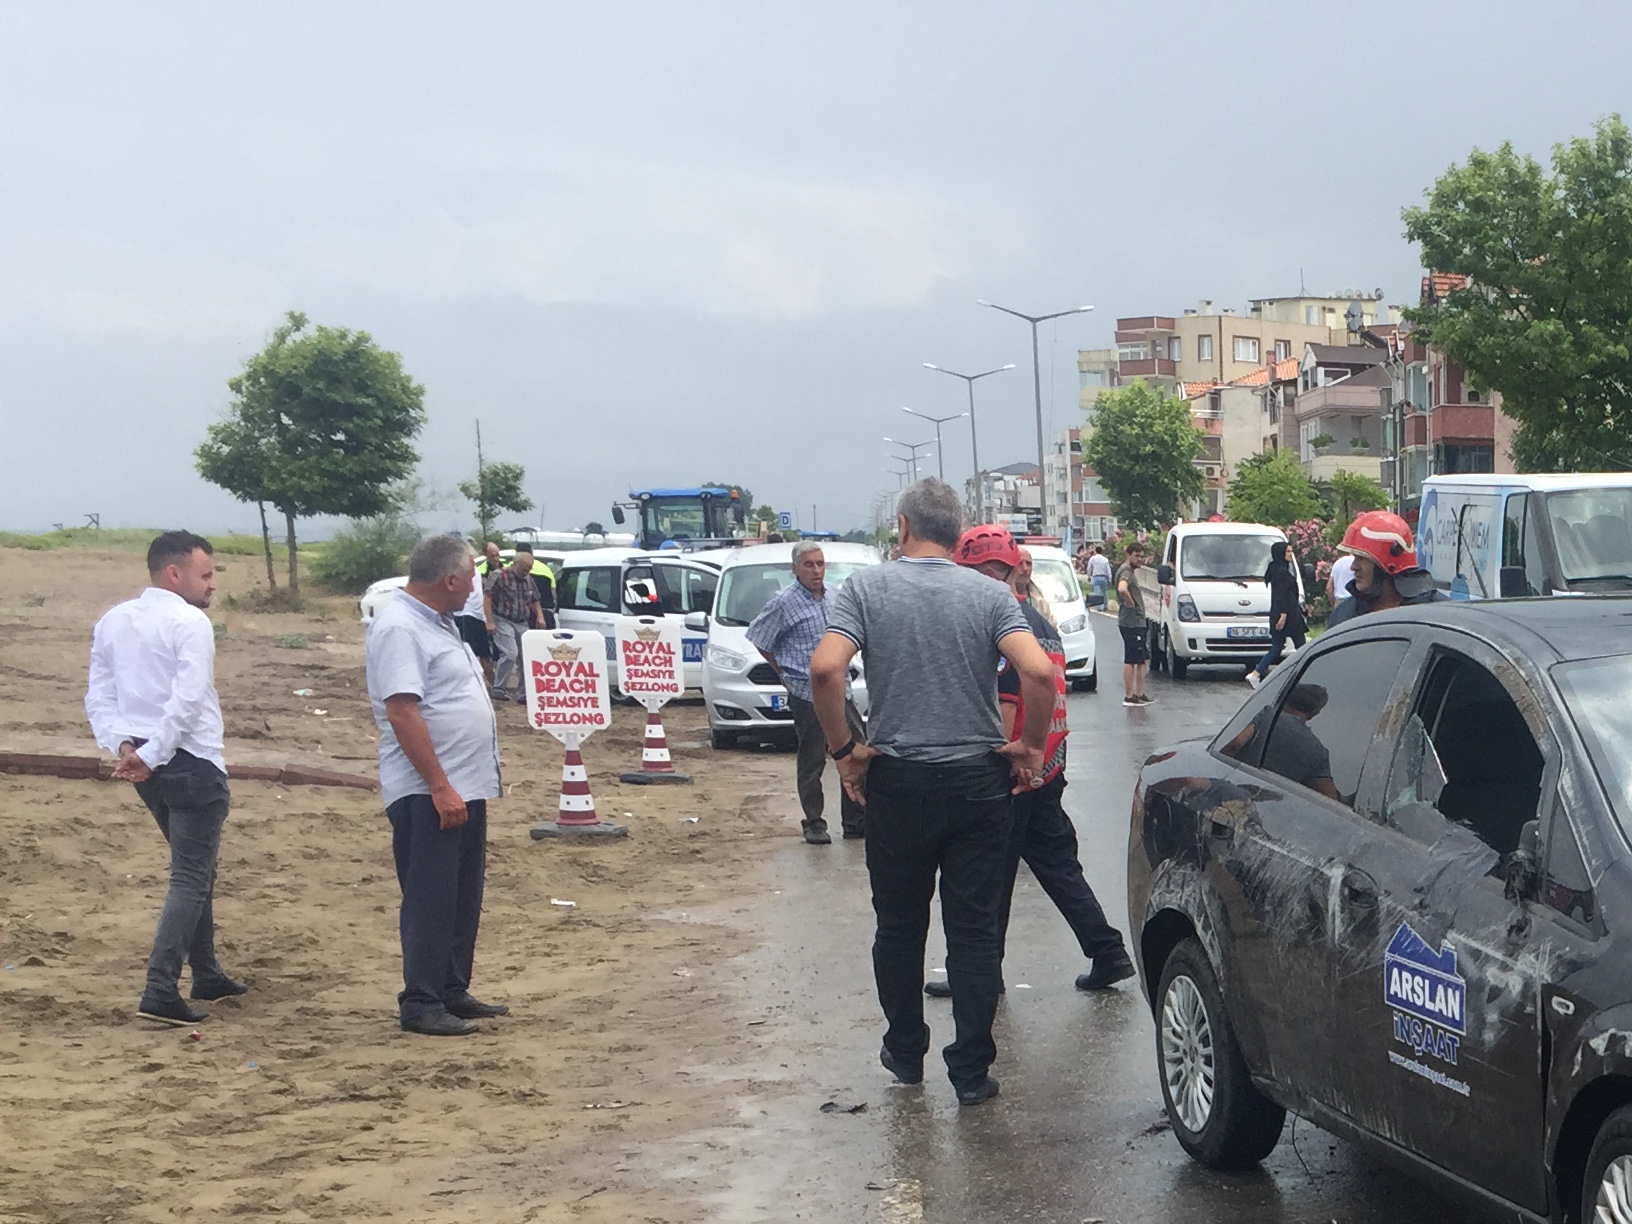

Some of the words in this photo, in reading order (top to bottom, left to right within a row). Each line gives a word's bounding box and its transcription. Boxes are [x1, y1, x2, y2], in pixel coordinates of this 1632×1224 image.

[782, 515, 789, 525] D
[622, 640, 675, 655] ROYAL
[531, 660, 600, 678] ROYAL
[623, 681, 679, 693] ŞEZLONG
[534, 712, 605, 727] ŞEZLONG
[1389, 968, 1461, 1021] ARSLAN
